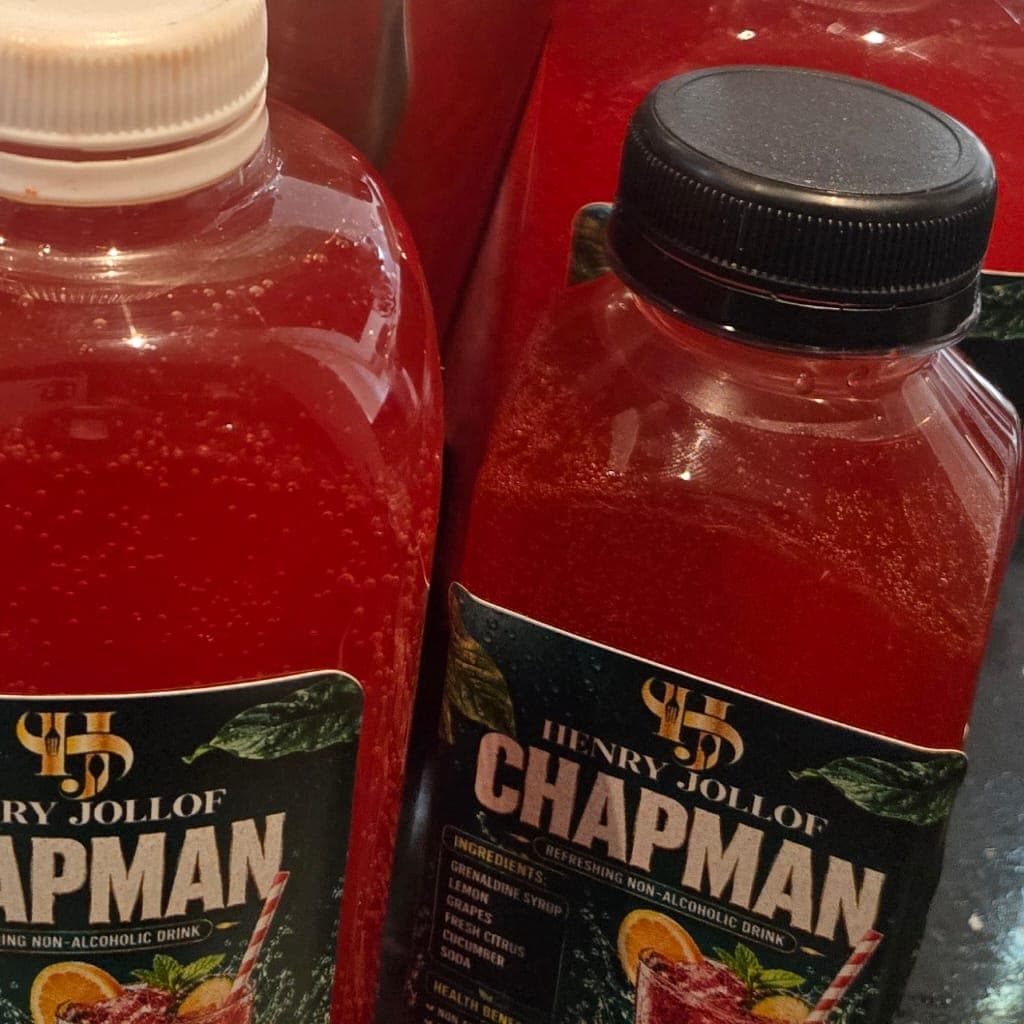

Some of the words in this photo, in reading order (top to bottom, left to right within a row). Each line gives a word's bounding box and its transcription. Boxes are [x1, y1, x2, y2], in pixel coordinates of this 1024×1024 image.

[541, 719, 671, 781] HENRY
[676, 767, 830, 838] JOLLOF
[68, 788, 227, 827] JOLLOF
[475, 732, 887, 950] CHAPMAN
[448, 877, 490, 905] LEMON
[450, 859, 521, 902] GRENALDINE
[523, 892, 564, 918] SYRUP
[545, 843, 624, 885] REFRESHING
[627, 876, 738, 929] NON-ALCOHOLIC
[741, 920, 787, 947] DRINK
[446, 894, 494, 925] GRAPES
[32, 932, 152, 949] NON-ALCOHOLIC
[156, 924, 201, 943] DRINK
[442, 929, 506, 968] CUCUMBER
[444, 911, 480, 938] FRESH
[483, 930, 527, 958] CITRUS
[439, 945, 472, 970] SODA
[433, 979, 479, 1012] HEALTH
